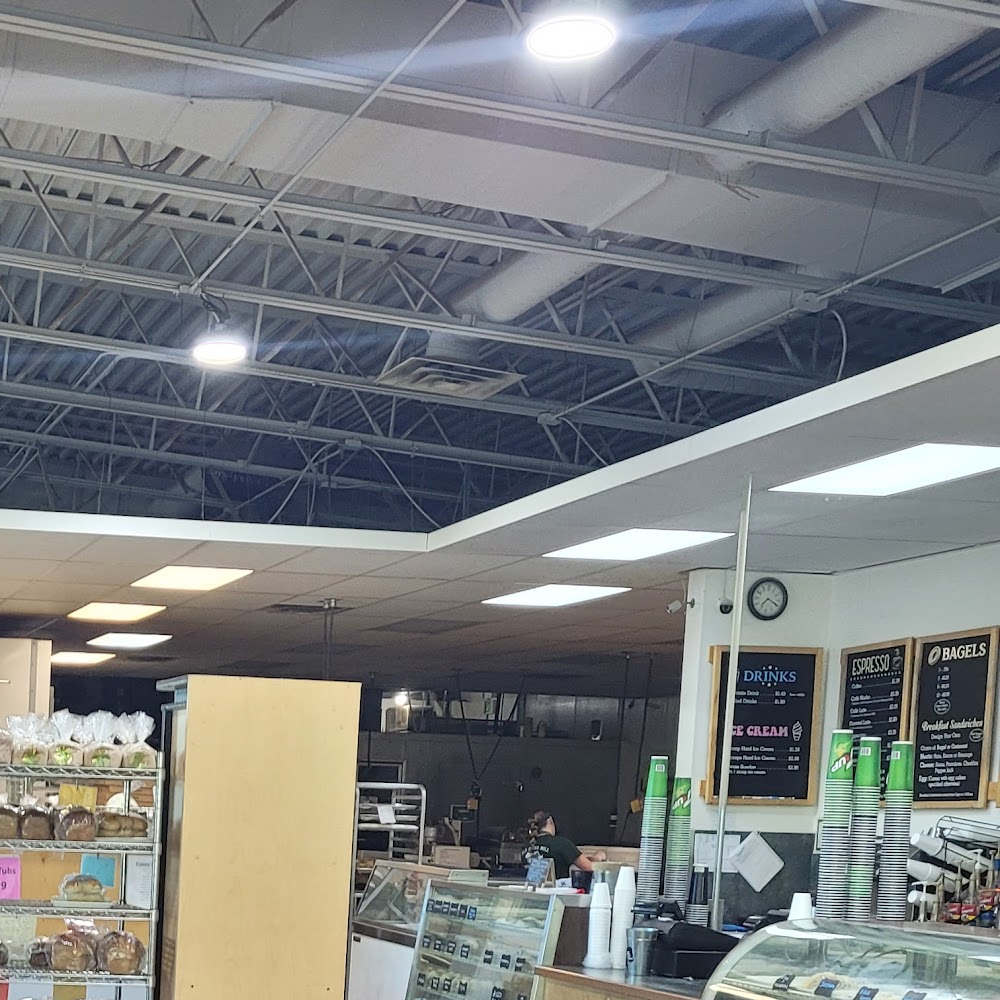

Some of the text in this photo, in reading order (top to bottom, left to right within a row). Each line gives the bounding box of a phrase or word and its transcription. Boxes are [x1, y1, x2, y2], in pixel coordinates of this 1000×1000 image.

[942, 642, 987, 661] BAGELS
[852, 654, 890, 676] ESPRESSO
[743, 670, 797, 682] DRINKS
[732, 725, 788, 737] CE CREAM
[922, 717, 983, 732] Breakfast Sandwiches
